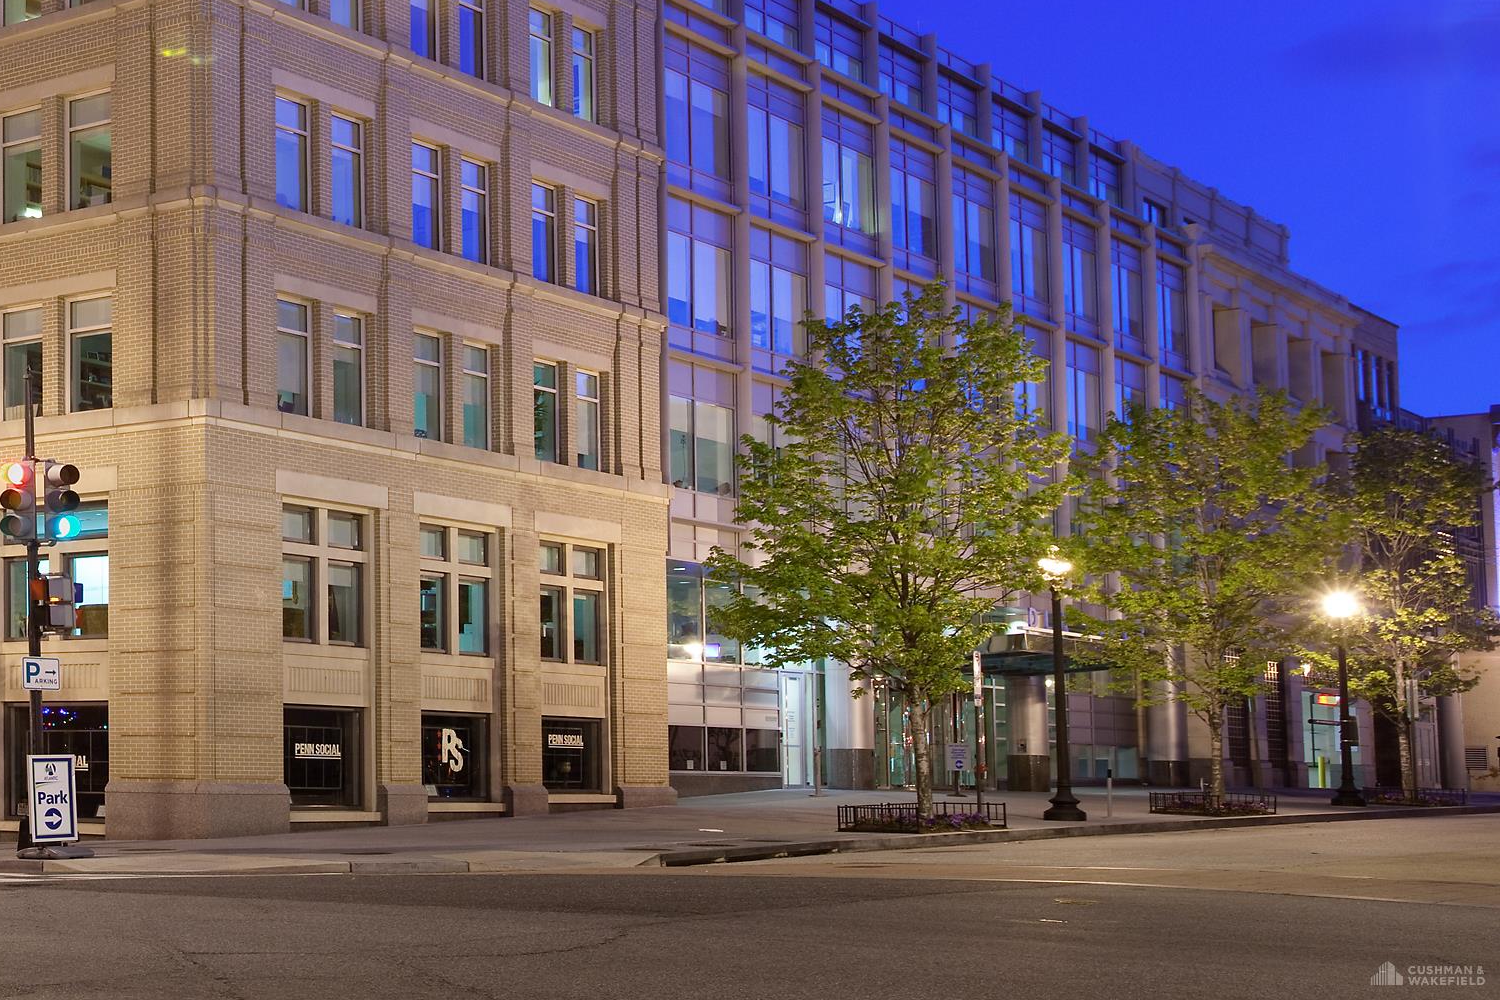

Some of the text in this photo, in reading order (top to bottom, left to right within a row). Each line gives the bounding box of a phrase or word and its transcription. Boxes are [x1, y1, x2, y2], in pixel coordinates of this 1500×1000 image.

[548, 734, 583, 746] PENN SOCIAL
[294, 743, 341, 756] PENN SOCIAL
[37, 790, 68, 804] Park
